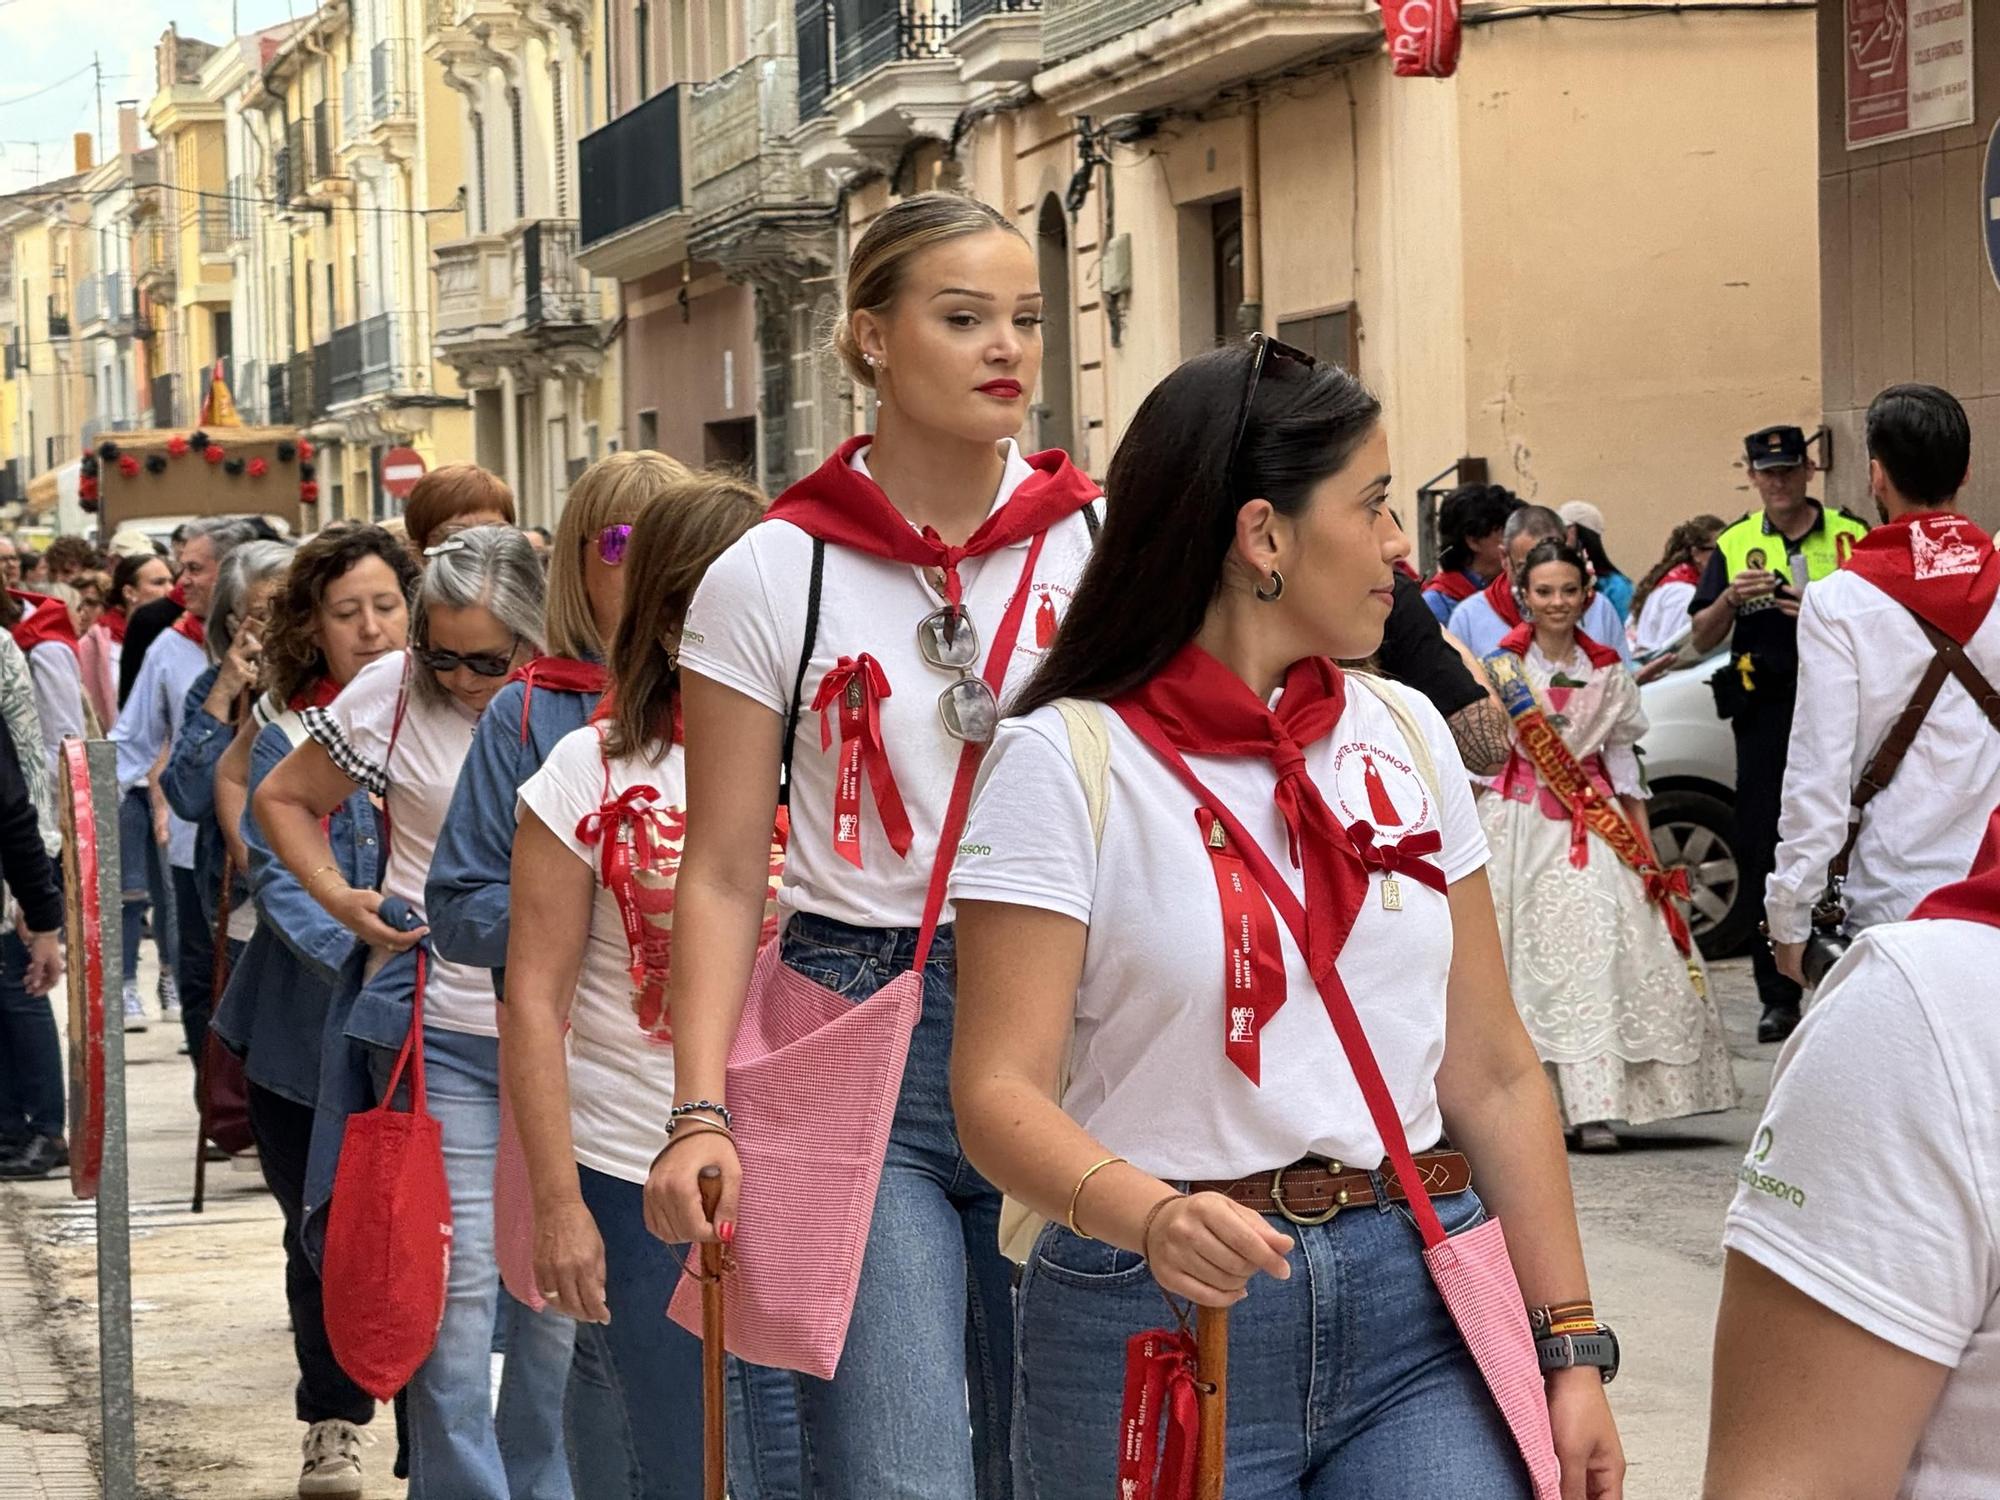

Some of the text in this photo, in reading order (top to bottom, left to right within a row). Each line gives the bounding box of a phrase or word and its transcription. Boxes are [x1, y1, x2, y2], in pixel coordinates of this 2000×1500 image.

[1914, 565, 1982, 580] ALMASSOR
[1351, 743, 1369, 752] DE
[1369, 744, 1412, 775] HONOR
[1231, 872, 1242, 893] 2024
[1241, 914, 1251, 954] quiteria
[1233, 949, 1241, 989] romeria
